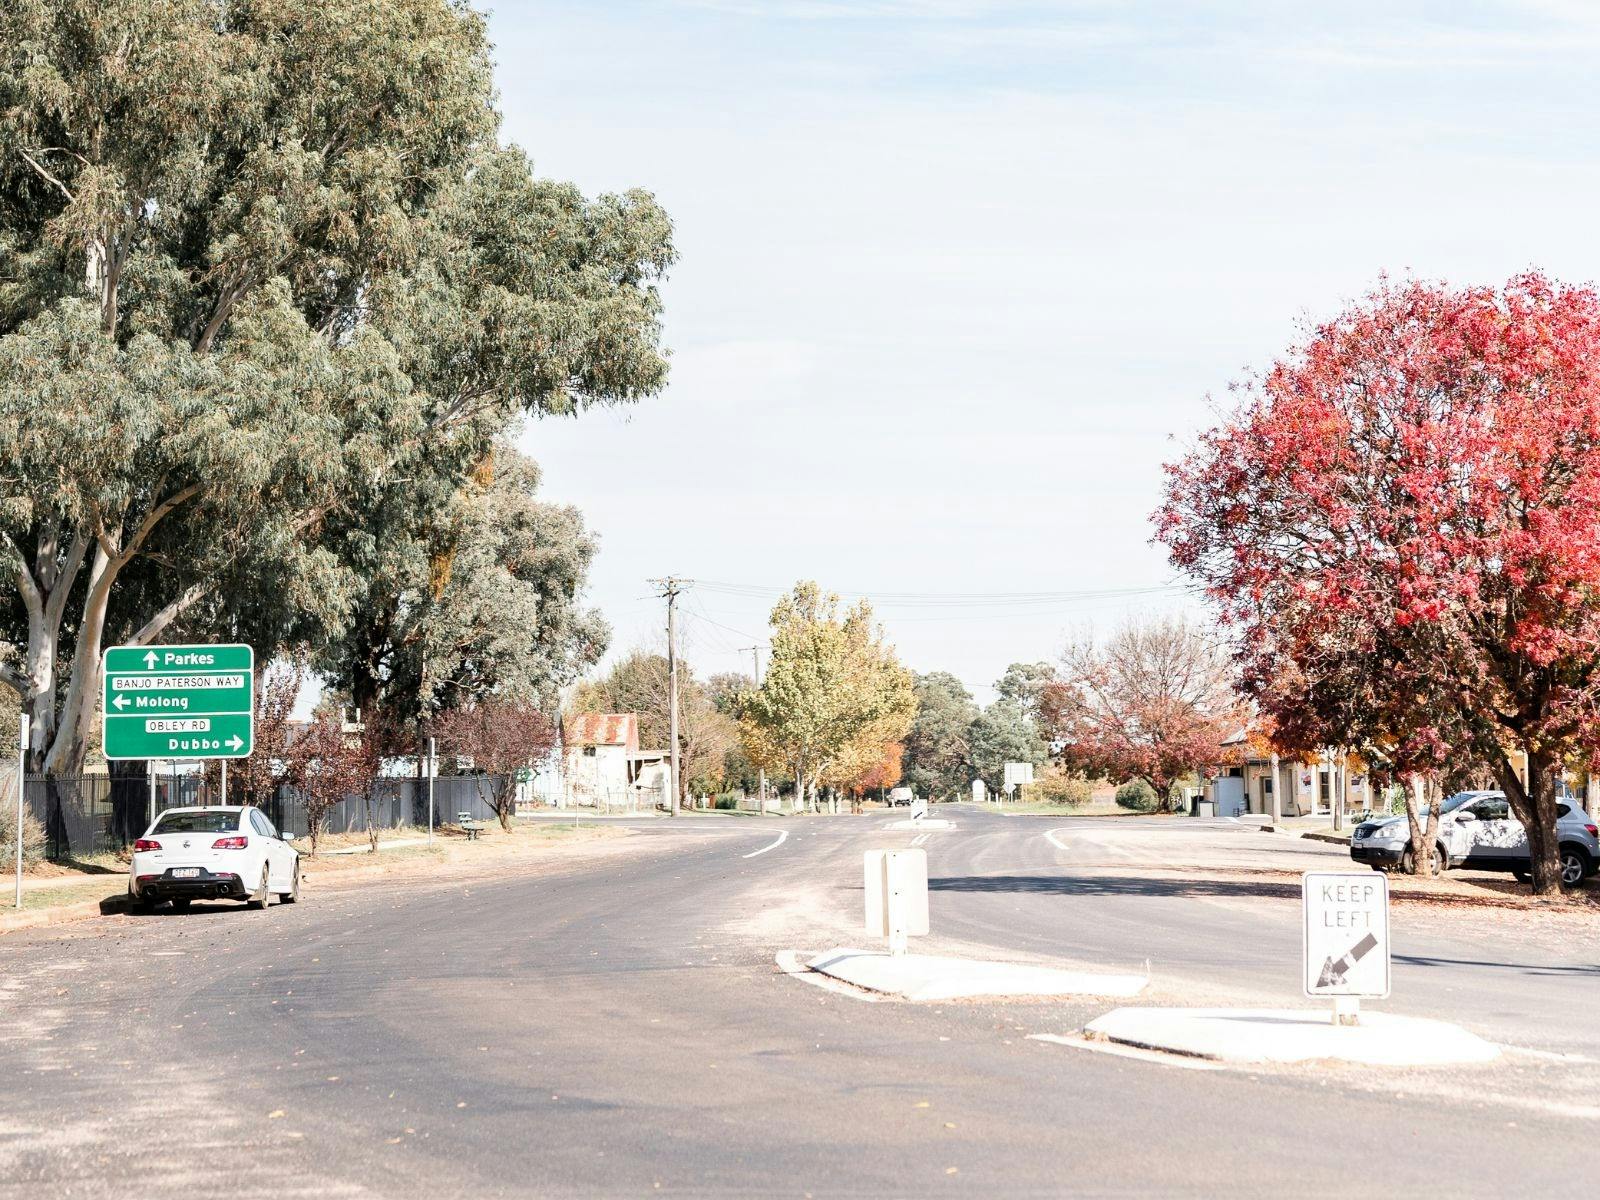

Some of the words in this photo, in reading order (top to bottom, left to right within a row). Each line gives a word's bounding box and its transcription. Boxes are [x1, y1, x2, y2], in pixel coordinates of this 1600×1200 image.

[164, 653, 214, 665] Parkes
[116, 678, 152, 689] BANJO
[157, 677, 211, 688] PATERSON
[216, 676, 239, 686] WAY
[136, 696, 189, 710] Molong
[149, 720, 187, 731] OBLEY
[191, 720, 206, 730] RD
[168, 738, 220, 750] Dubbo
[1322, 884, 1374, 903] KEEP
[1324, 910, 1372, 928] LEFT
